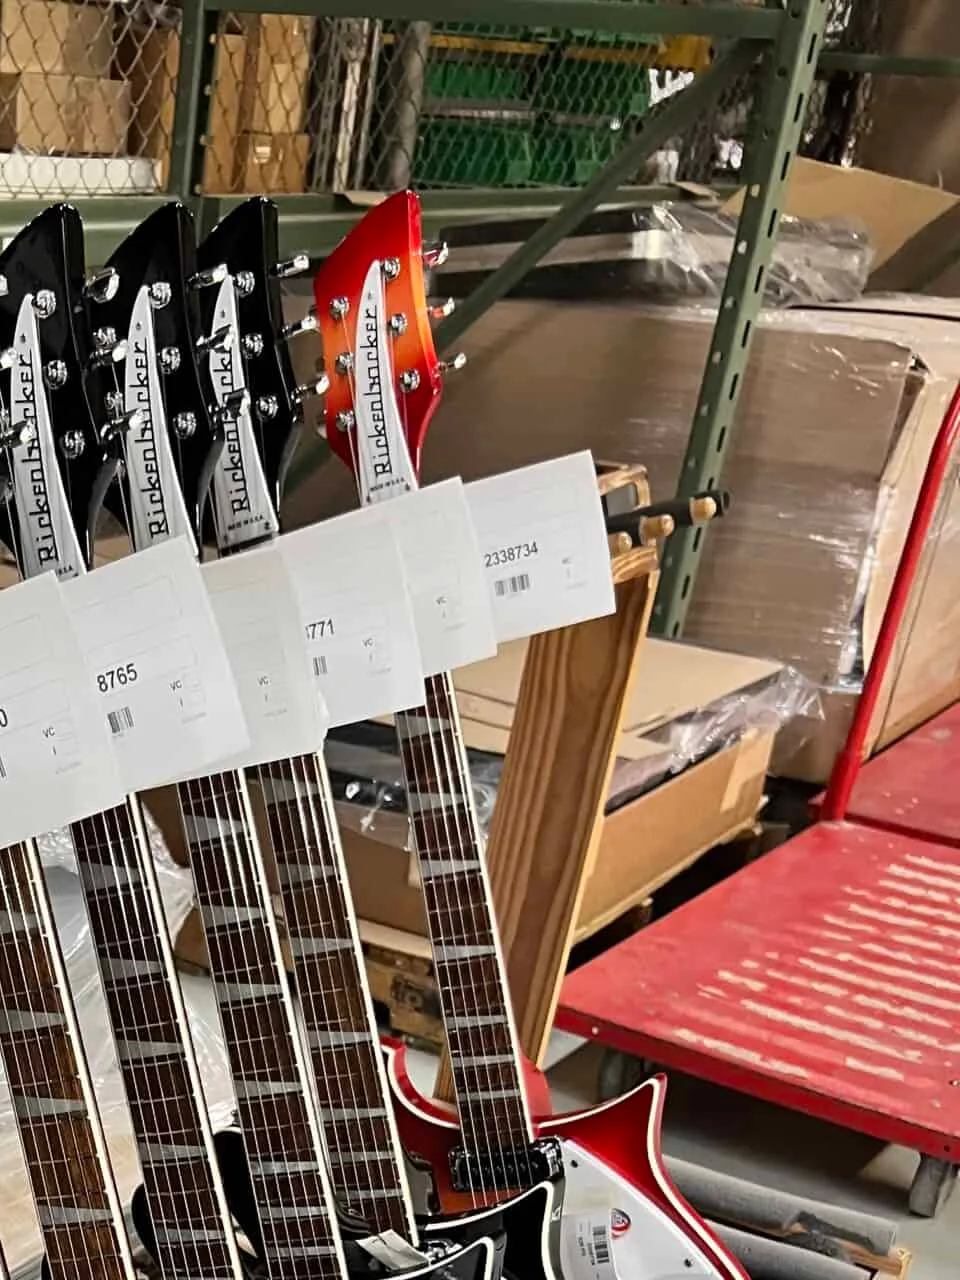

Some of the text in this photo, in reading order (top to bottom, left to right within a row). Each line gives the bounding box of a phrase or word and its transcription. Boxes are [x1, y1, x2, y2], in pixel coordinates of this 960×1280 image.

[360, 304, 392, 479] Rickenbacker
[484, 541, 539, 568] 2338734
[97, 663, 138, 692] 8765
[42, 725, 55, 738] VC
